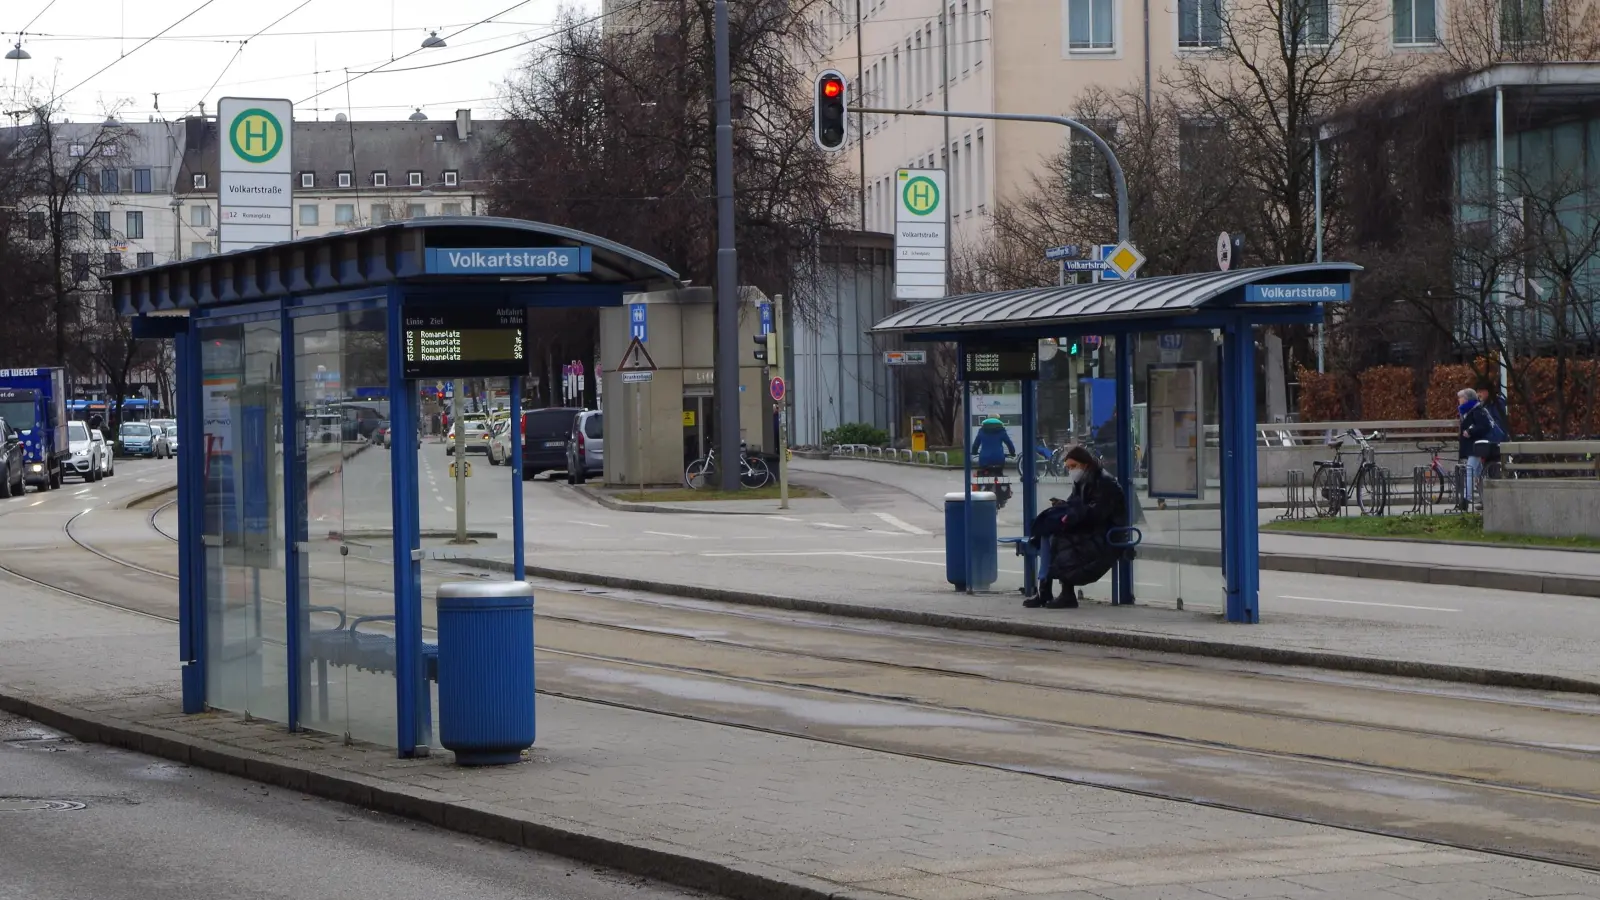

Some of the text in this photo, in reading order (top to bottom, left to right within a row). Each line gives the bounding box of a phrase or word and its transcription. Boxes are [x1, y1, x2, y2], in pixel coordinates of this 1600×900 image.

[229, 185, 282, 194] Volkartstraße
[902, 231, 939, 239] Volkartstraße
[449, 251, 569, 268] Volkartstraße
[1261, 286, 1337, 298] Volkartstraße
[430, 317, 444, 325] Ziel
[500, 316, 508, 324] in
[510, 316, 523, 324] Min
[514, 351, 523, 360] 36
[0, 368, 38, 378] ER WEISSE
